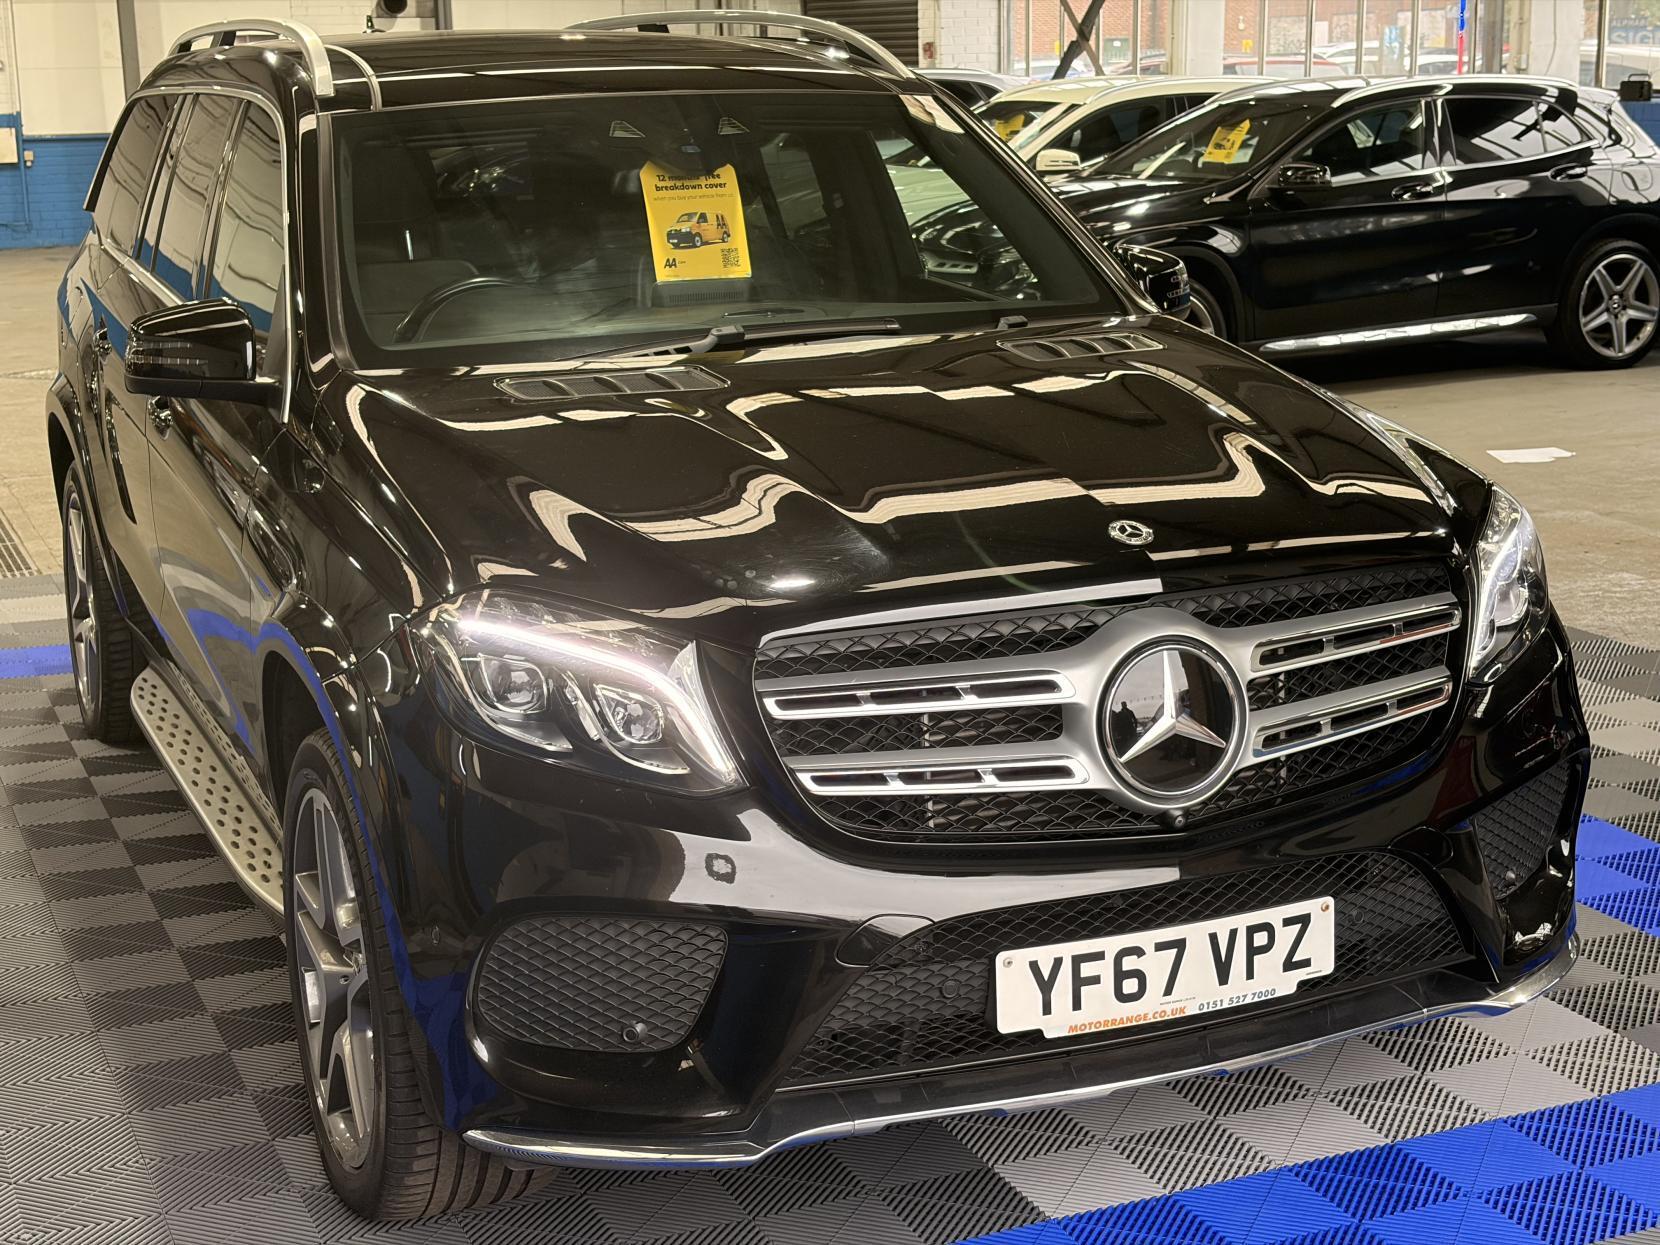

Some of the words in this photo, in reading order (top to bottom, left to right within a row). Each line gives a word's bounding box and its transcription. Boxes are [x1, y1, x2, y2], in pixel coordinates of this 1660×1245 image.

[655, 182, 703, 191] breakdown
[705, 182, 727, 190] cover
[664, 257, 677, 268] AA
[1028, 937, 1187, 1016] YF67
[1208, 912, 1312, 987] VPZ
[1067, 1006, 1187, 1034] MOTORRANGE.CO.UK
[1198, 999, 1224, 1012] 0151
[1228, 994, 1247, 1006] 527
[1251, 988, 1276, 1002] 7000
